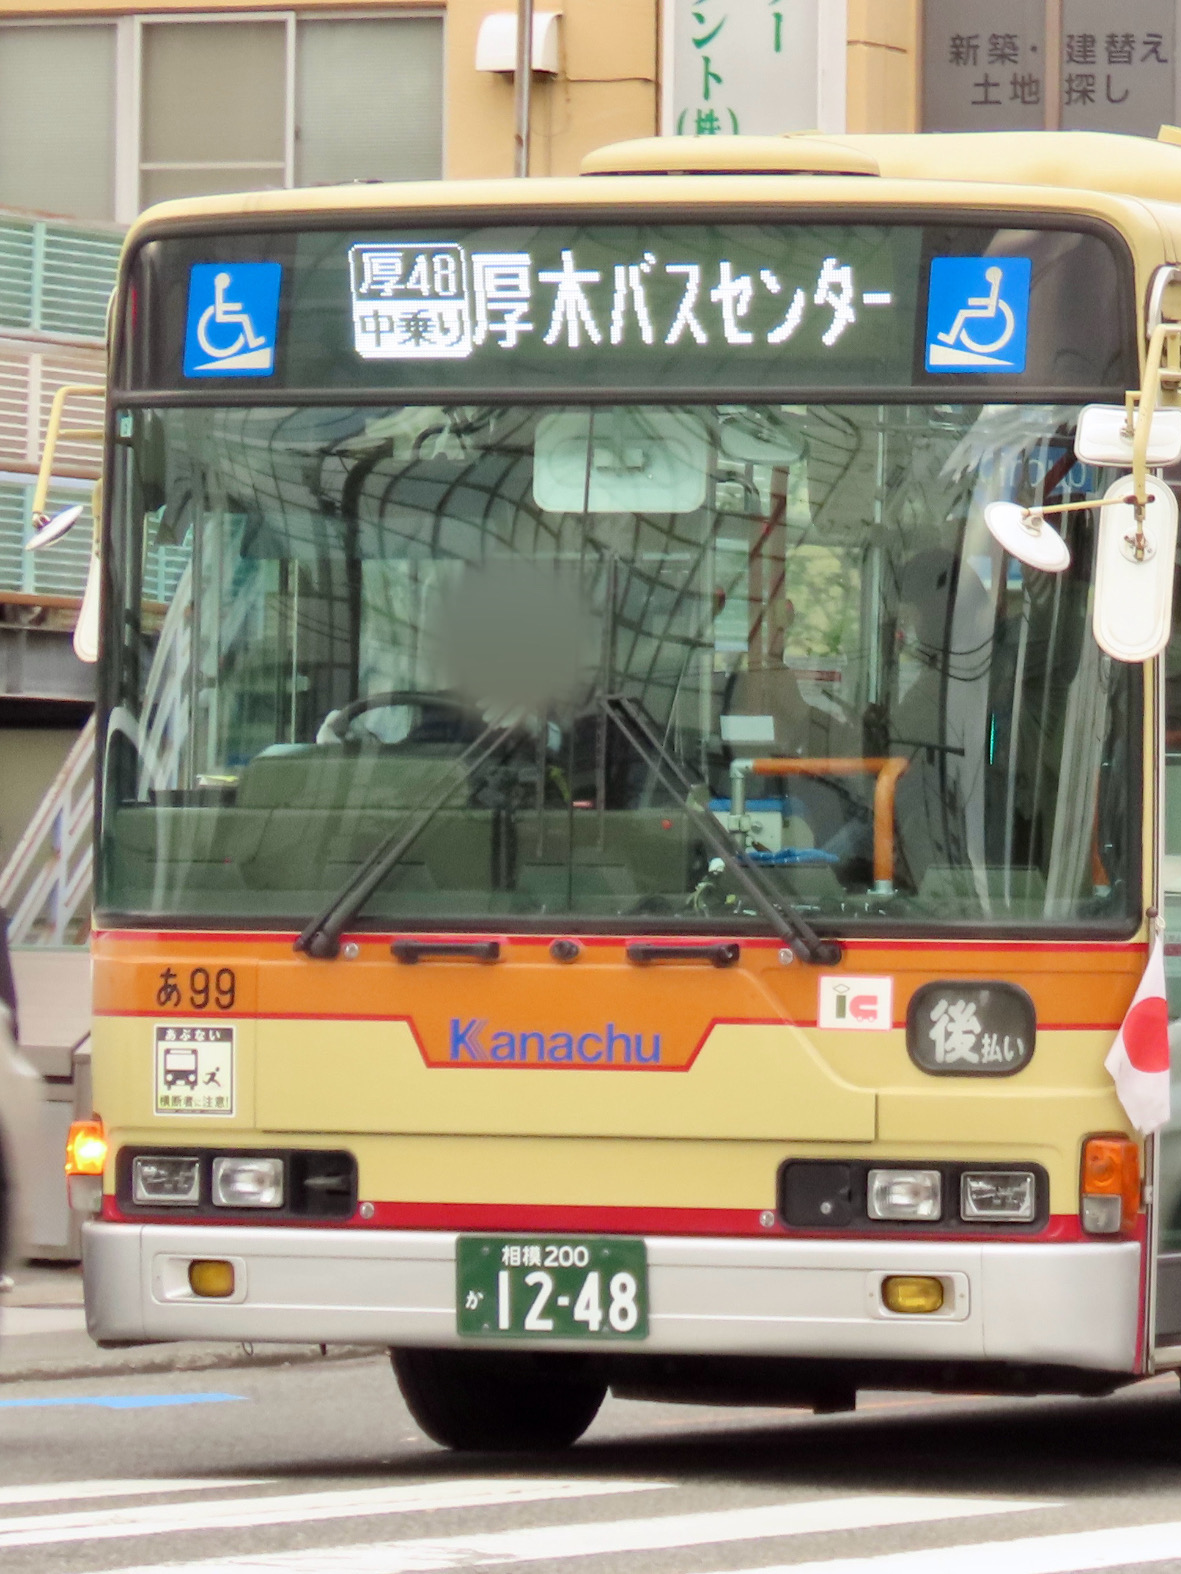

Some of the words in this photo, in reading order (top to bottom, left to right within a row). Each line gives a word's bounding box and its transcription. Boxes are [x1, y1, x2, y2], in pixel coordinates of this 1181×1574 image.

[677, 0, 738, 135] ント(株)
[949, 33, 1168, 66] 新築・建替え
[971, 73, 1129, 106] 土地探し
[359, 252, 457, 296] 厚48
[471, 250, 893, 347] 厚木バスセンター
[359, 309, 464, 347] 中乗り
[157, 967, 236, 1010] あ99
[164, 1028, 221, 1041] あぶない
[449, 1018, 661, 1064] Kanachu
[929, 998, 1026, 1065] 後払い
[465, 1290, 483, 1310] か
[498, 1271, 638, 1332] 12-48
